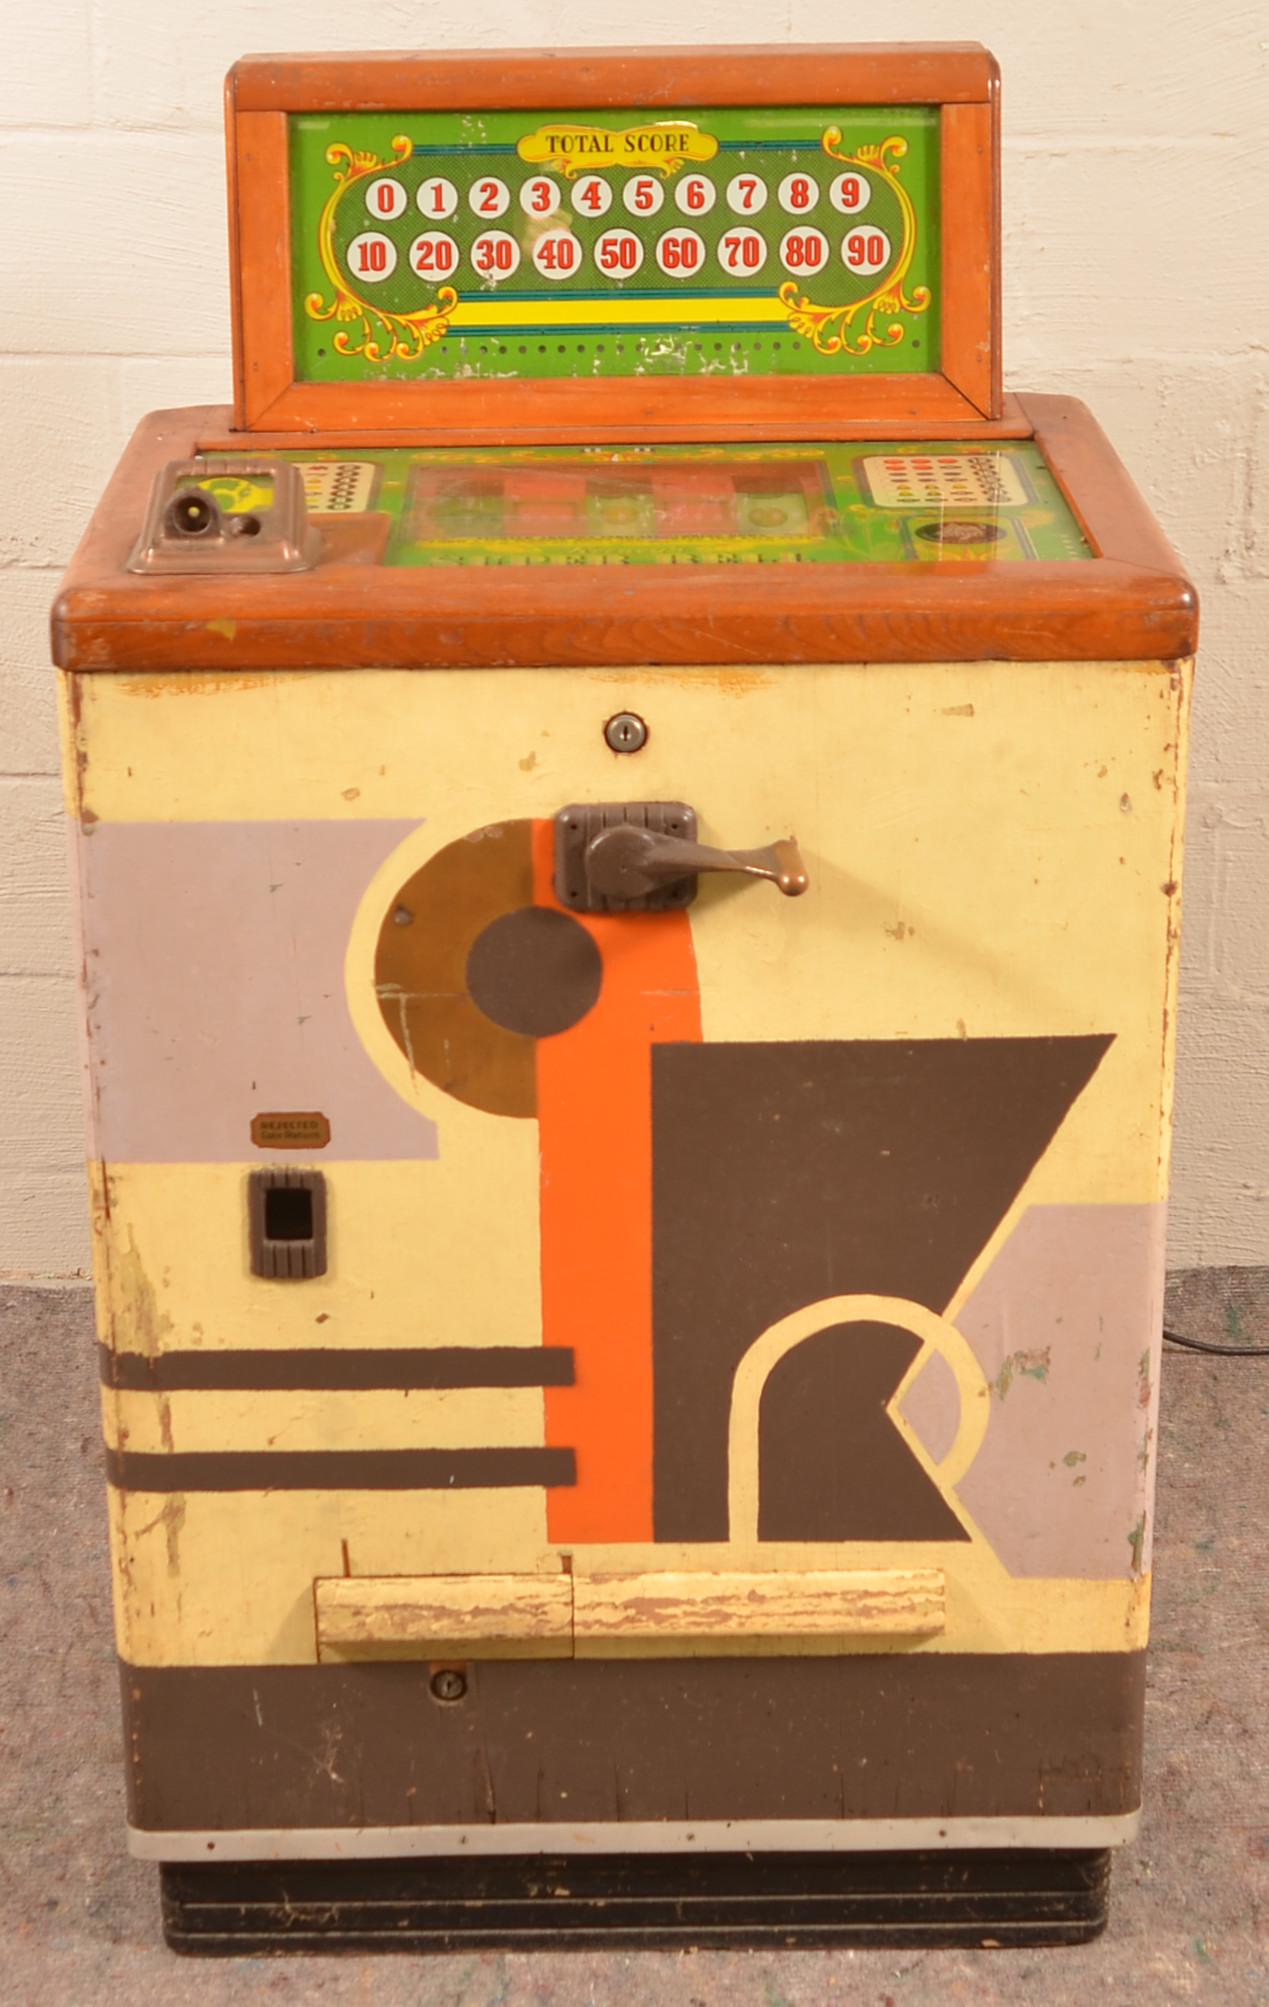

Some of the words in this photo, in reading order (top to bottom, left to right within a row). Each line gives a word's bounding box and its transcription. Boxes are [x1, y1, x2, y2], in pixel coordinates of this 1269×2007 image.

[546, 135, 613, 153] TOTAL
[624, 134, 689, 152] SCORE
[377, 184, 395, 213] 0
[432, 184, 446, 212] 1
[479, 183, 500, 212] 2
[532, 182, 552, 212] 3
[581, 182, 601, 211] 4
[634, 181, 654, 210] 5
[687, 181, 705, 210] 6
[738, 180, 757, 209] 7
[790, 179, 810, 208] 8
[840, 178, 861, 208] 9
[358, 241, 388, 272] 10
[416, 241, 453, 272] 20
[475, 240, 513, 271] 30
[536, 239, 575, 271] 40
[600, 238, 638, 270] 50
[662, 237, 699, 270] 60
[724, 236, 761, 268] 70
[785, 236, 823, 268] 80
[847, 236, 885, 267] 90
